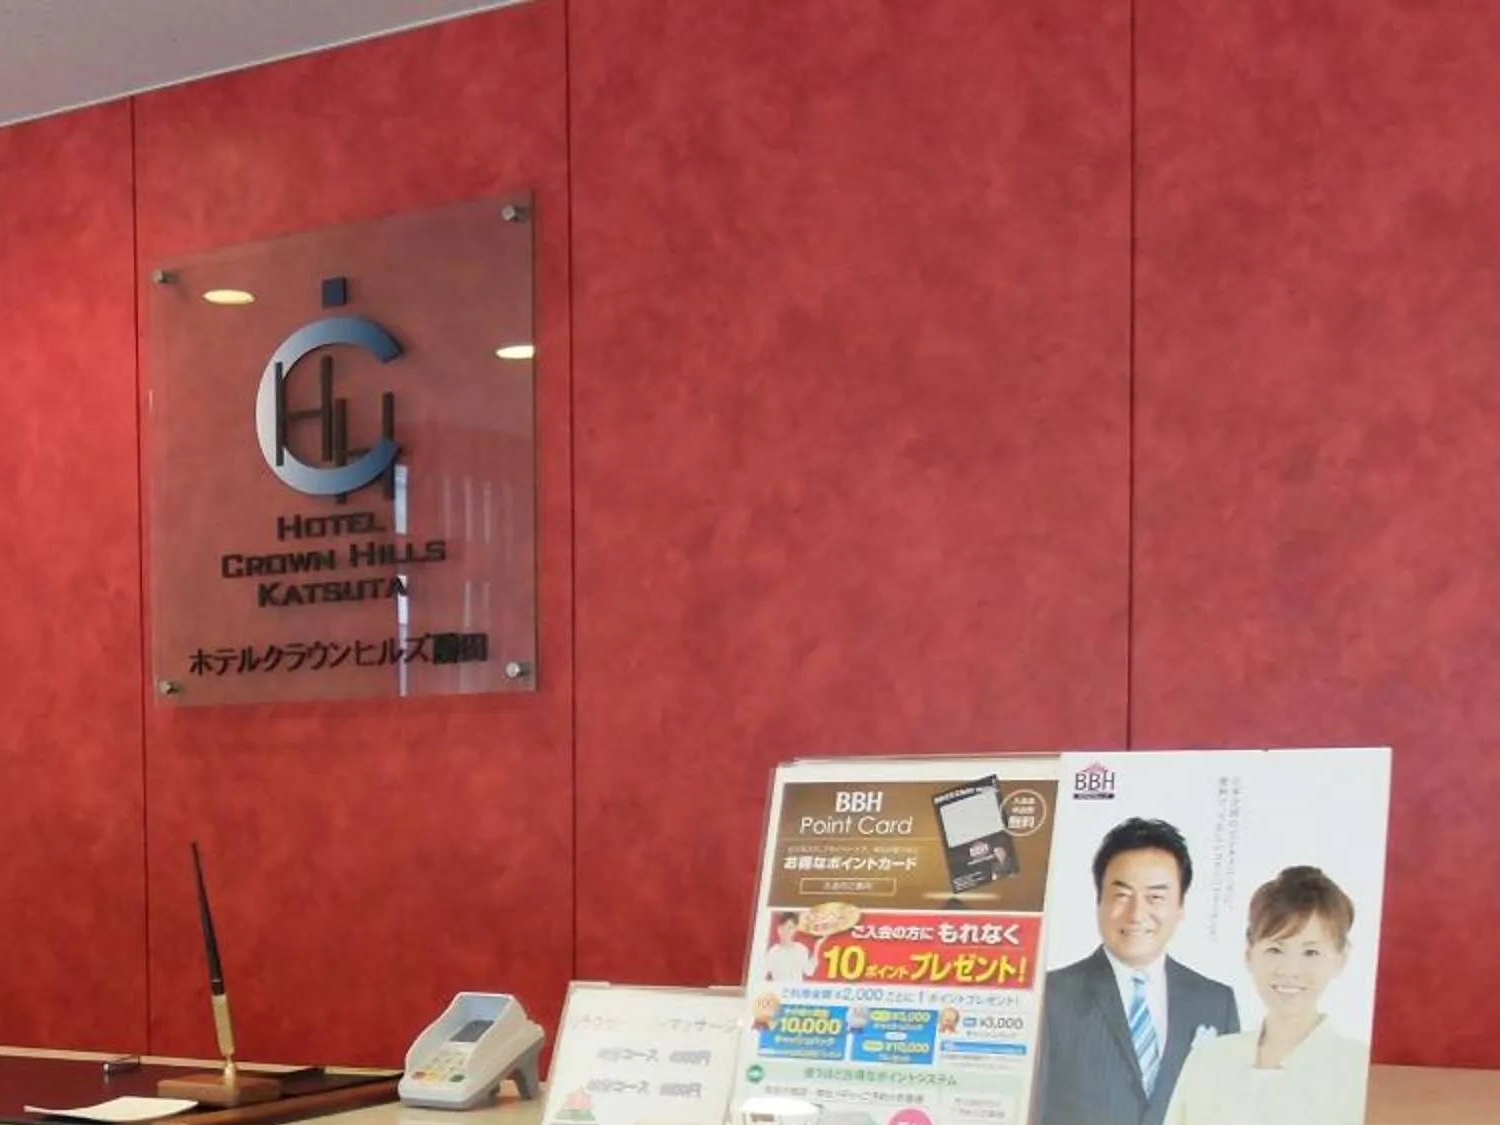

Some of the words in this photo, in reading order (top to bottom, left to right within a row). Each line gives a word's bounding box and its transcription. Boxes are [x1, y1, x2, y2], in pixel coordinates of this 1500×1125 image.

[276, 511, 387, 541] HOTEL
[220, 543, 336, 579] CROWN
[349, 539, 447, 568] HILLS
[257, 576, 408, 608] KATSUTA
[1074, 771, 1116, 792] BBH
[834, 791, 884, 813] BBH
[799, 816, 851, 835] Point
[857, 815, 913, 835] Card
[783, 855, 917, 871] お得なポイントカード
[937, 923, 1020, 945] もれなく
